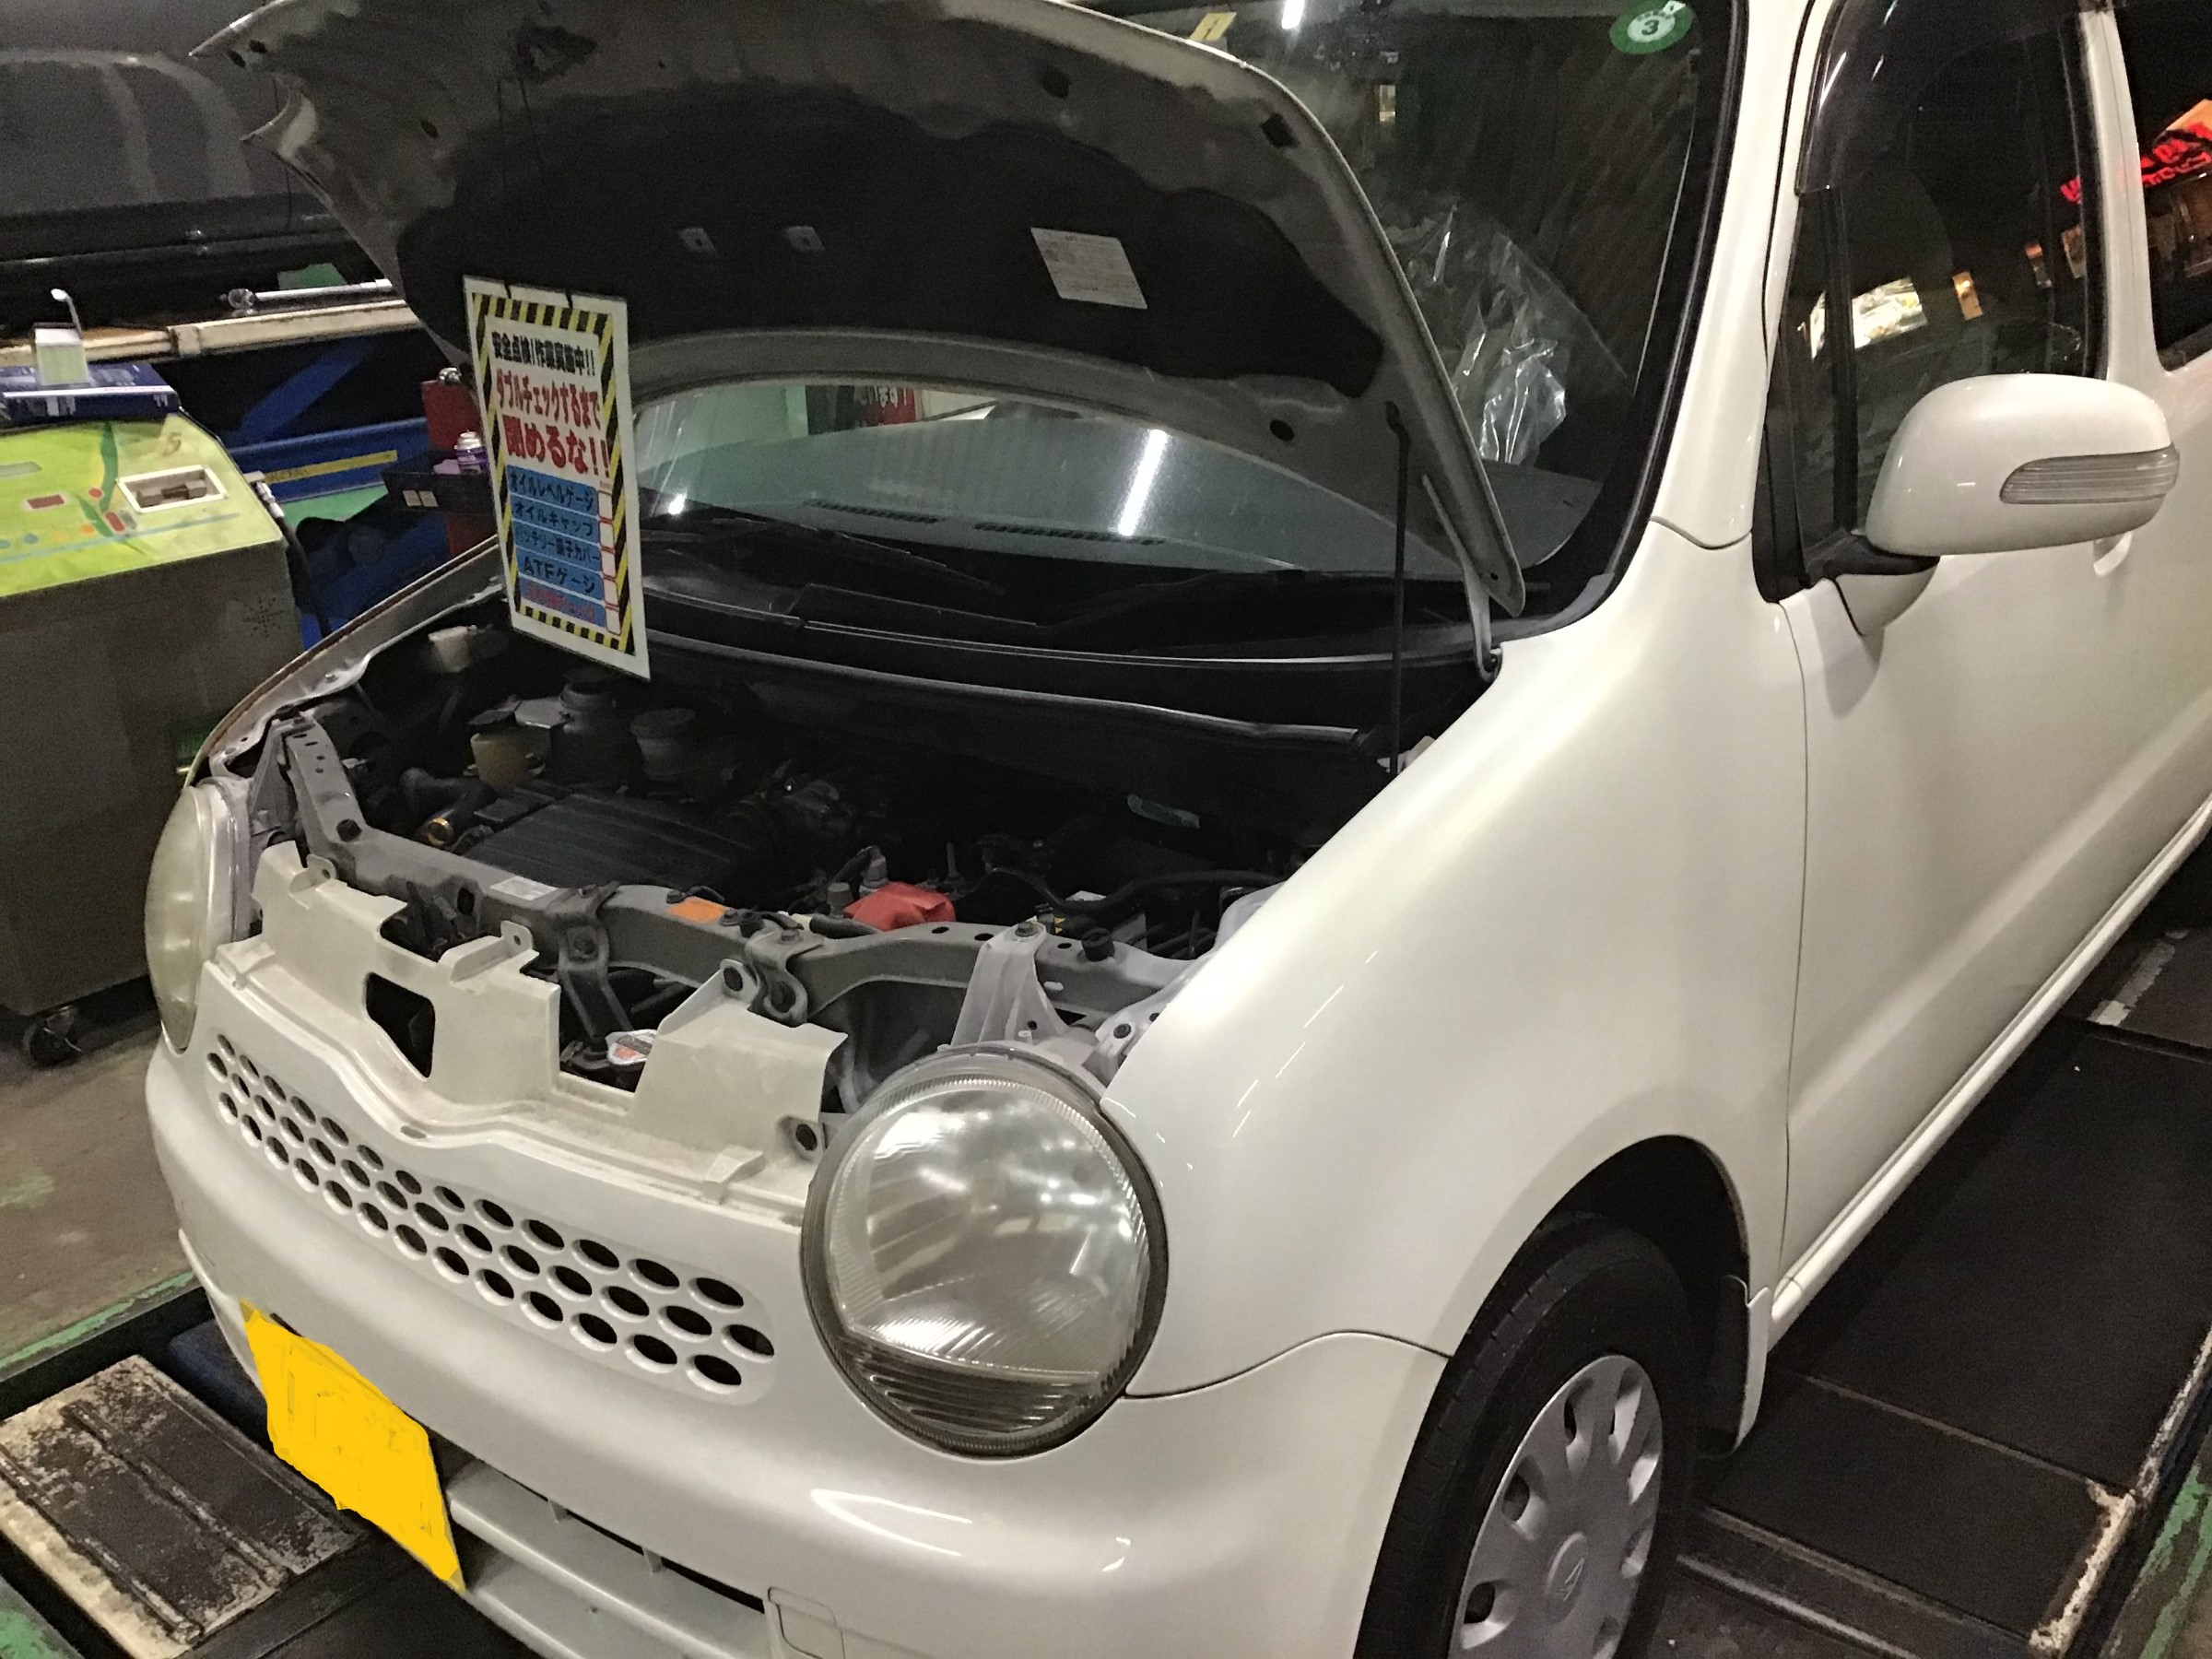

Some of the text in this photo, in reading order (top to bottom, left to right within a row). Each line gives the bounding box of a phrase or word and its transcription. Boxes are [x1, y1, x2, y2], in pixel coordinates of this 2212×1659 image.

[1641, 19, 1660, 36] 3
[524, 556, 595, 594] ATFゲージ
